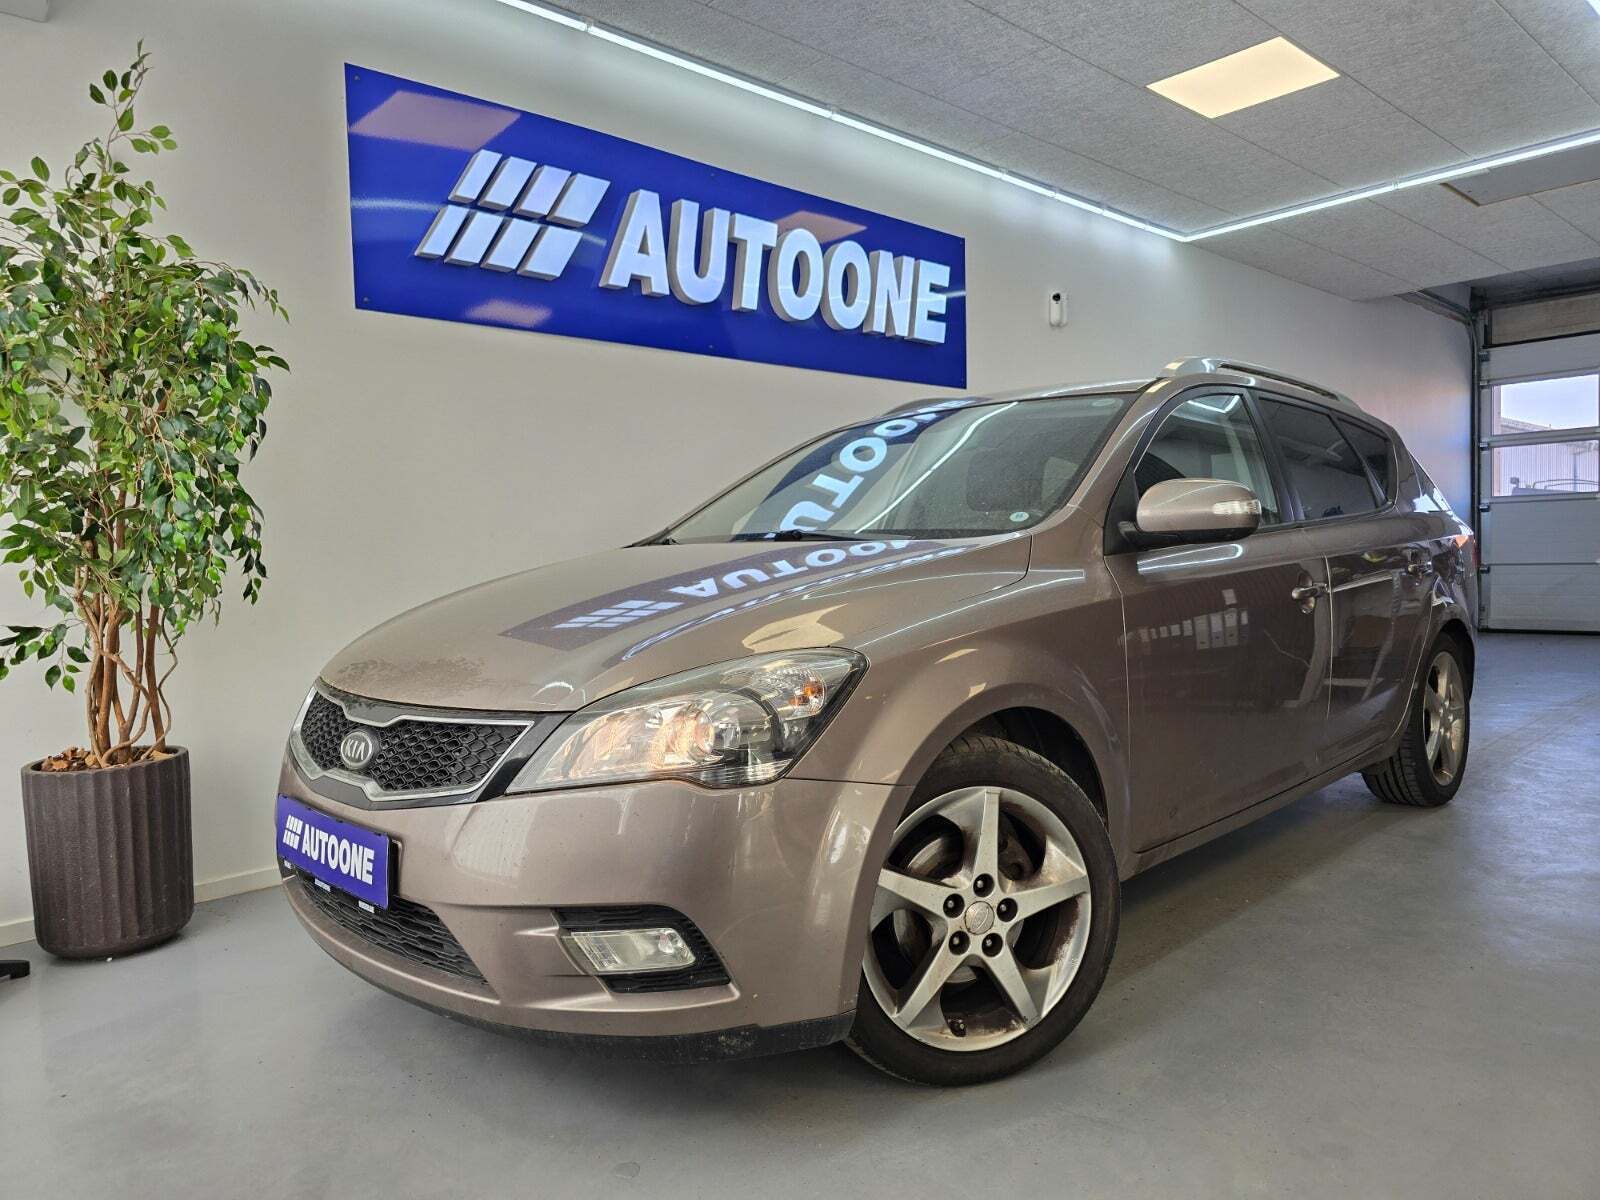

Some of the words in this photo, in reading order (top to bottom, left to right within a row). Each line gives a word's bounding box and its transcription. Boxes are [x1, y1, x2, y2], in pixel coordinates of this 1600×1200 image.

[600, 189, 950, 344] AUTOONE
[345, 738, 366, 760] KIA
[302, 823, 375, 886] AUTOONE
